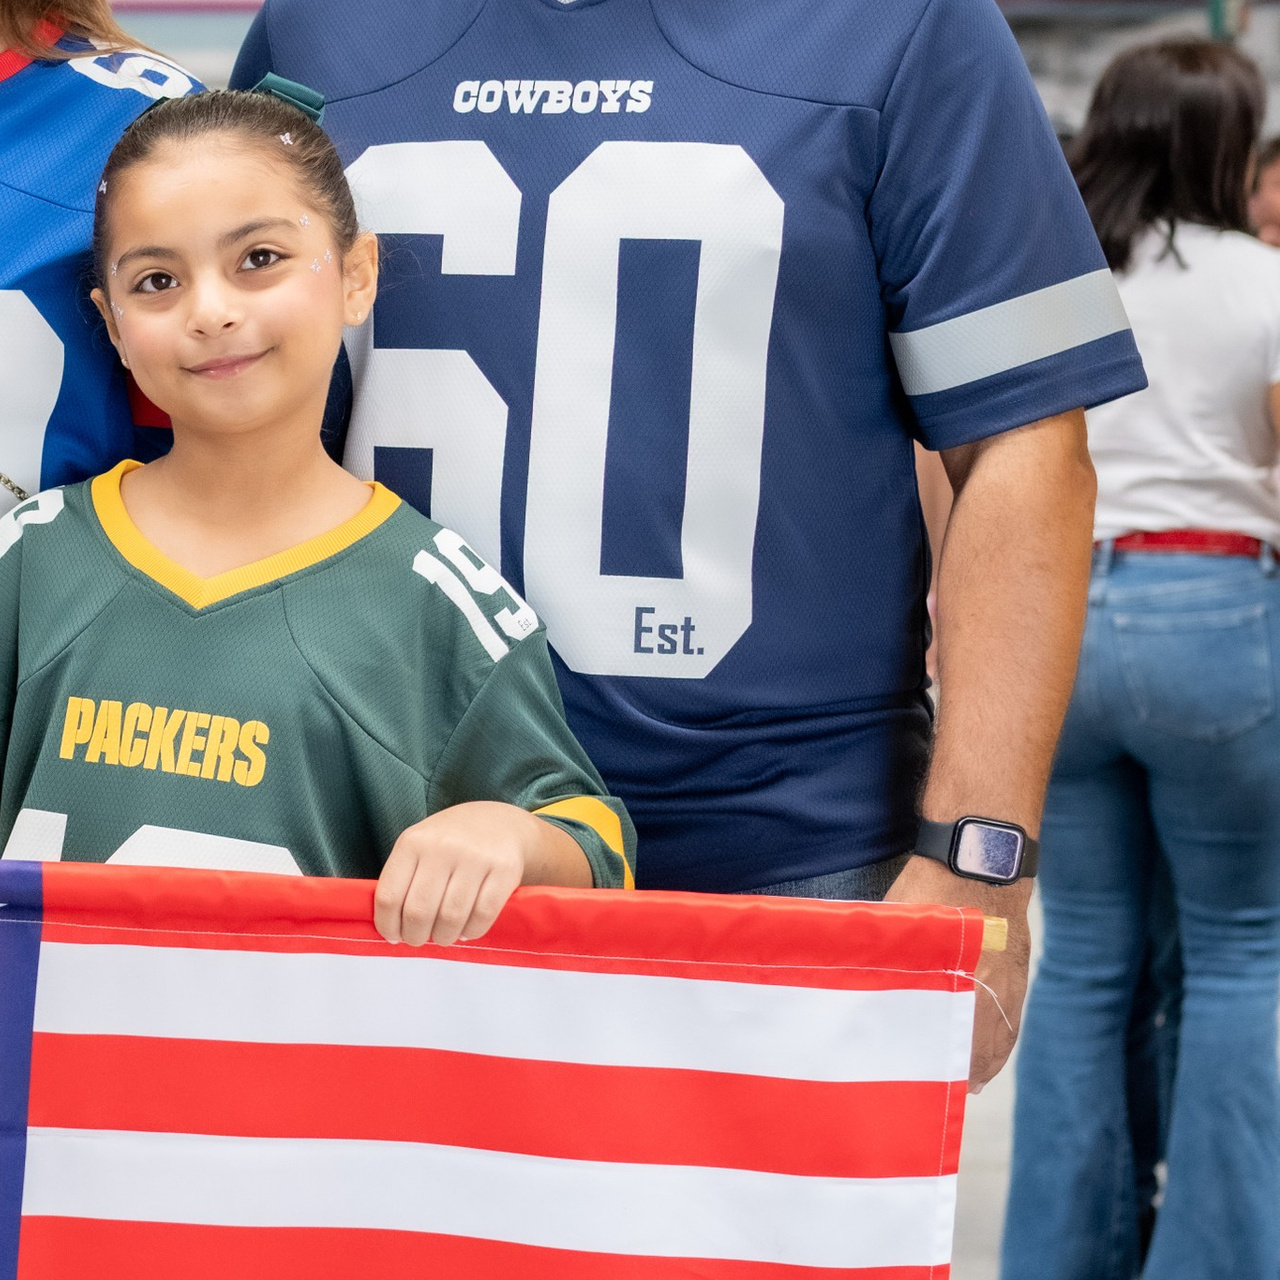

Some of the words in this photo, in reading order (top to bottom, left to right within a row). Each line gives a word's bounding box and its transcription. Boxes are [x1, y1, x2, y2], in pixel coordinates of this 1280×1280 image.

[452, 79, 654, 115] COWBOYS
[341, 139, 787, 680] 60
[411, 527, 540, 664] 19
[633, 606, 705, 655] Est.
[58, 696, 271, 787] PACKERS
